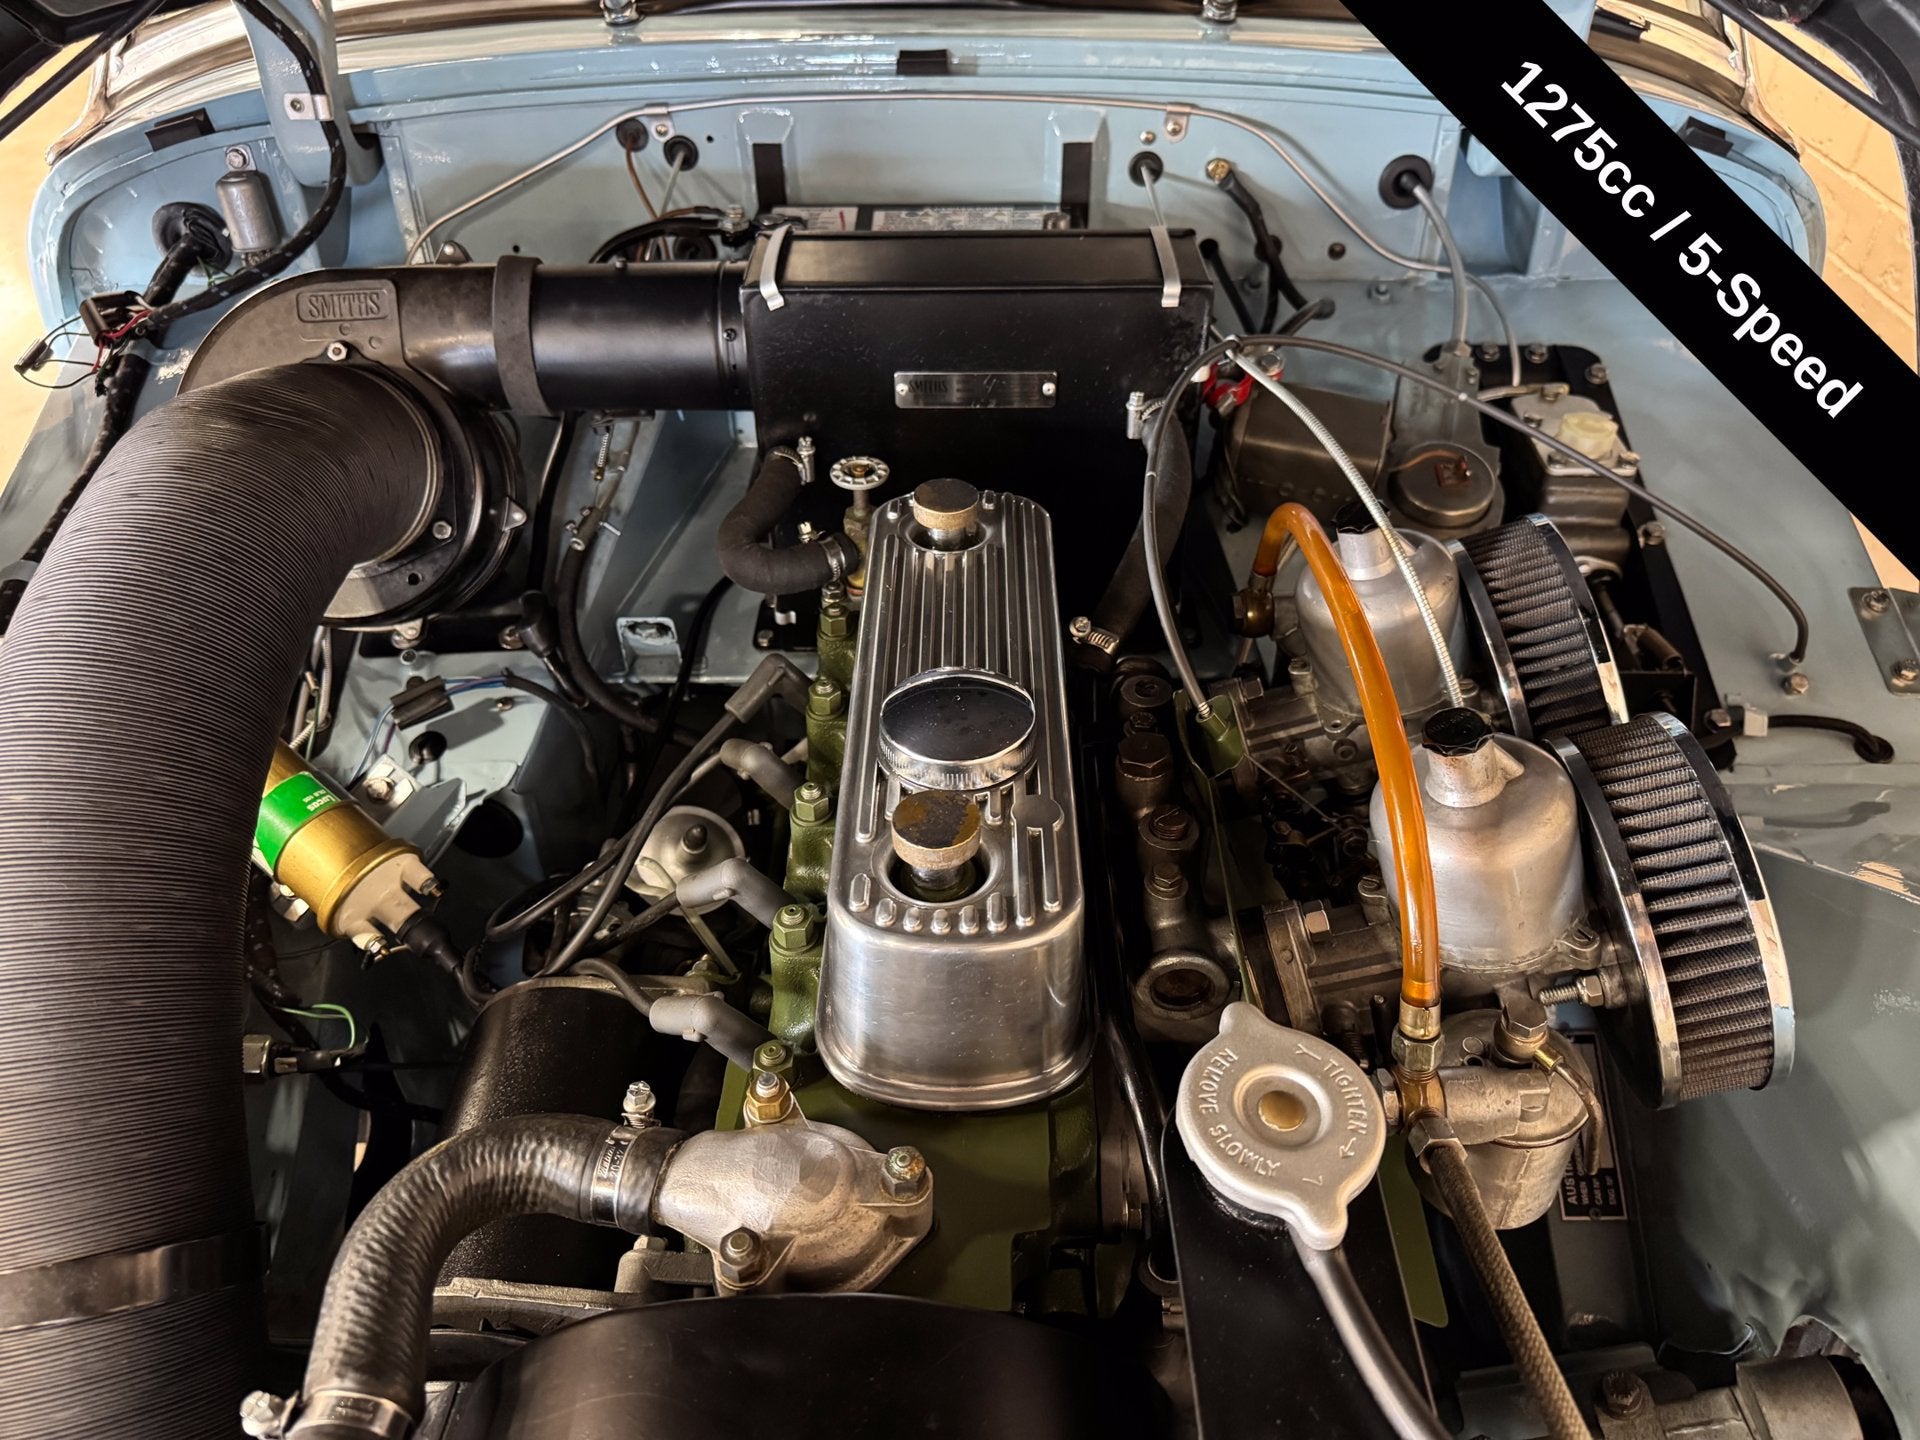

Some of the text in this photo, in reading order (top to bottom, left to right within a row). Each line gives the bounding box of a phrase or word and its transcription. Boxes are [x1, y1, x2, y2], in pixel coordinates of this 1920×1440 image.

[308, 292, 381, 319] SMITHS
[1198, 1047, 1280, 1177] REMOVE SLOWLY
[1323, 1058, 1368, 1135] TIGHTEN
